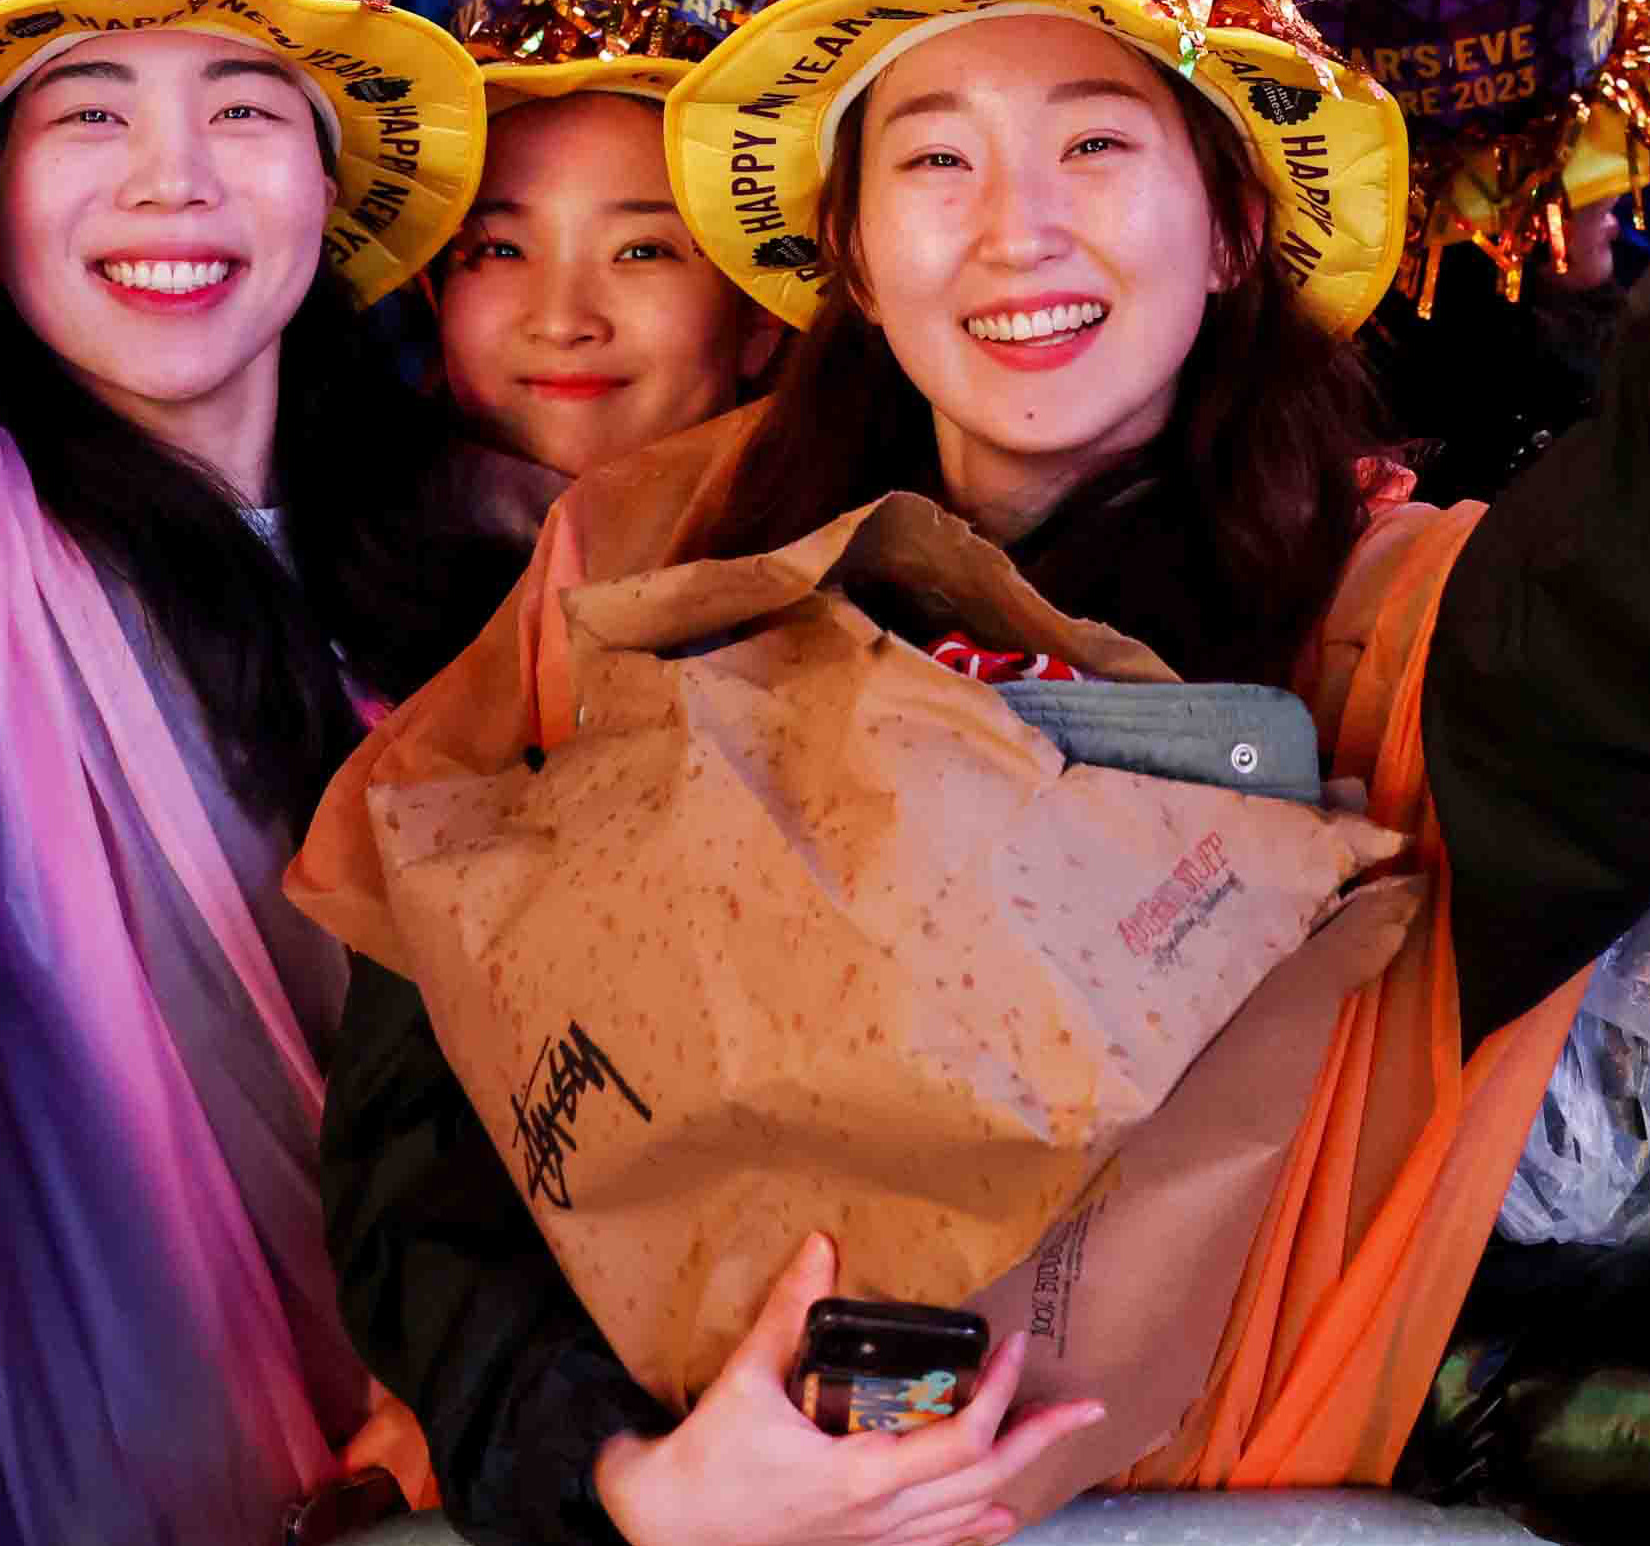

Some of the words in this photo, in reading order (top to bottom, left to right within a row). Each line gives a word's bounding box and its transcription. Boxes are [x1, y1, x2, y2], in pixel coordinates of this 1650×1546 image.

[1455, 23, 1536, 74] EVE
[731, 130, 786, 235] HAPPY
[776, 18, 873, 86] YEAR
[1454, 66, 1537, 112] 2023
[1280, 134, 1338, 238] HAPPY
